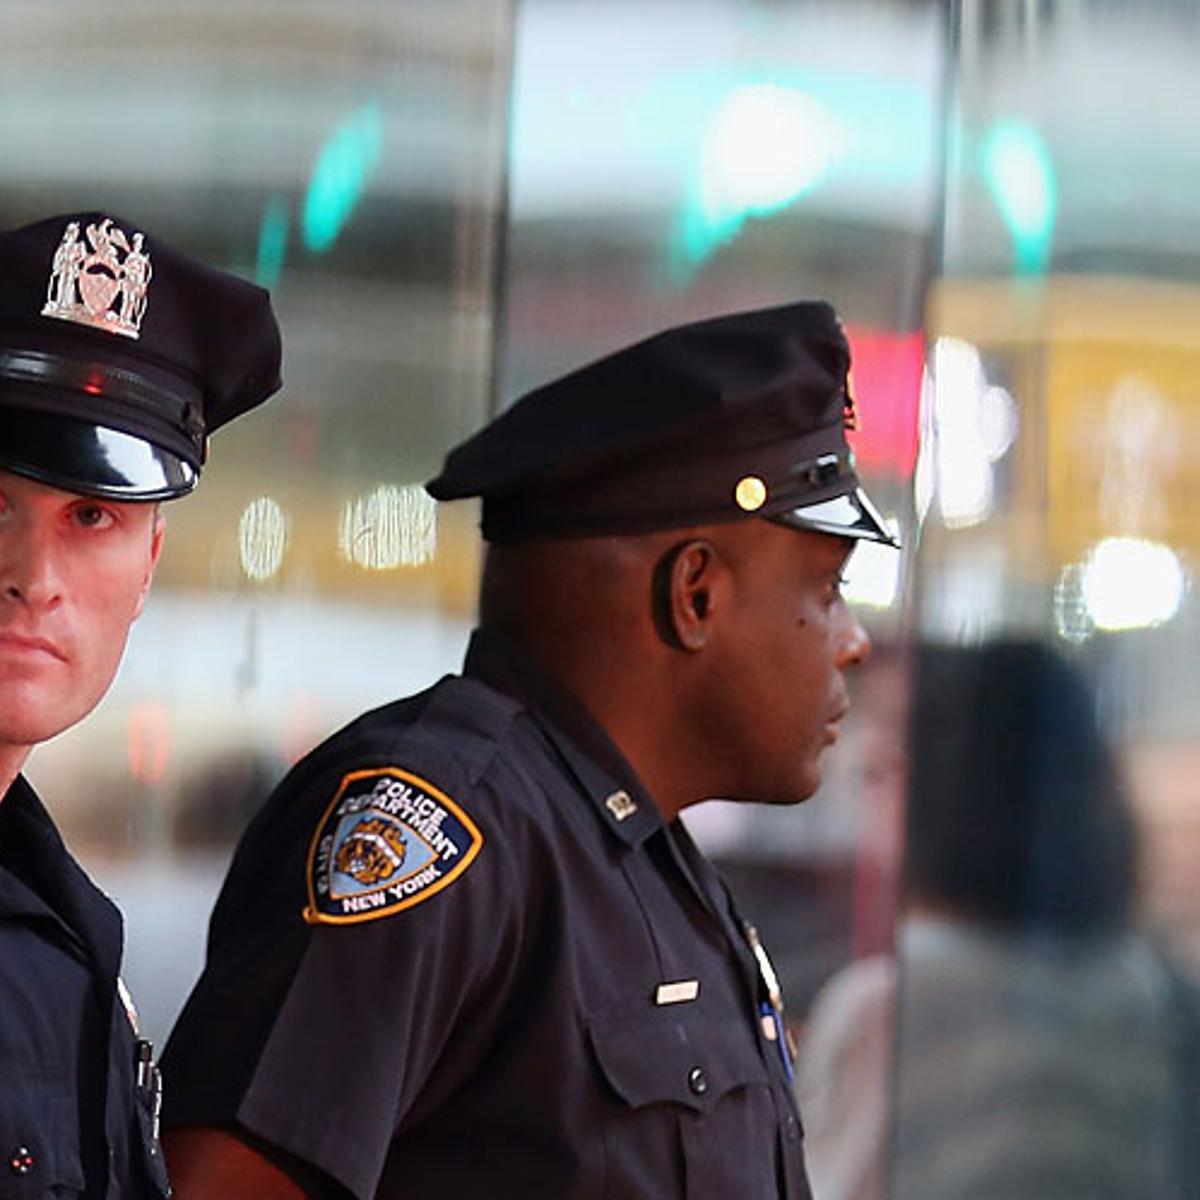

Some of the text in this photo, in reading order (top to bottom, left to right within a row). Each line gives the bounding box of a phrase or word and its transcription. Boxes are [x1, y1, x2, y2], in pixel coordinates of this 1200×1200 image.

[372, 778, 448, 826] POLICE
[343, 863, 442, 913] NEW YORK
